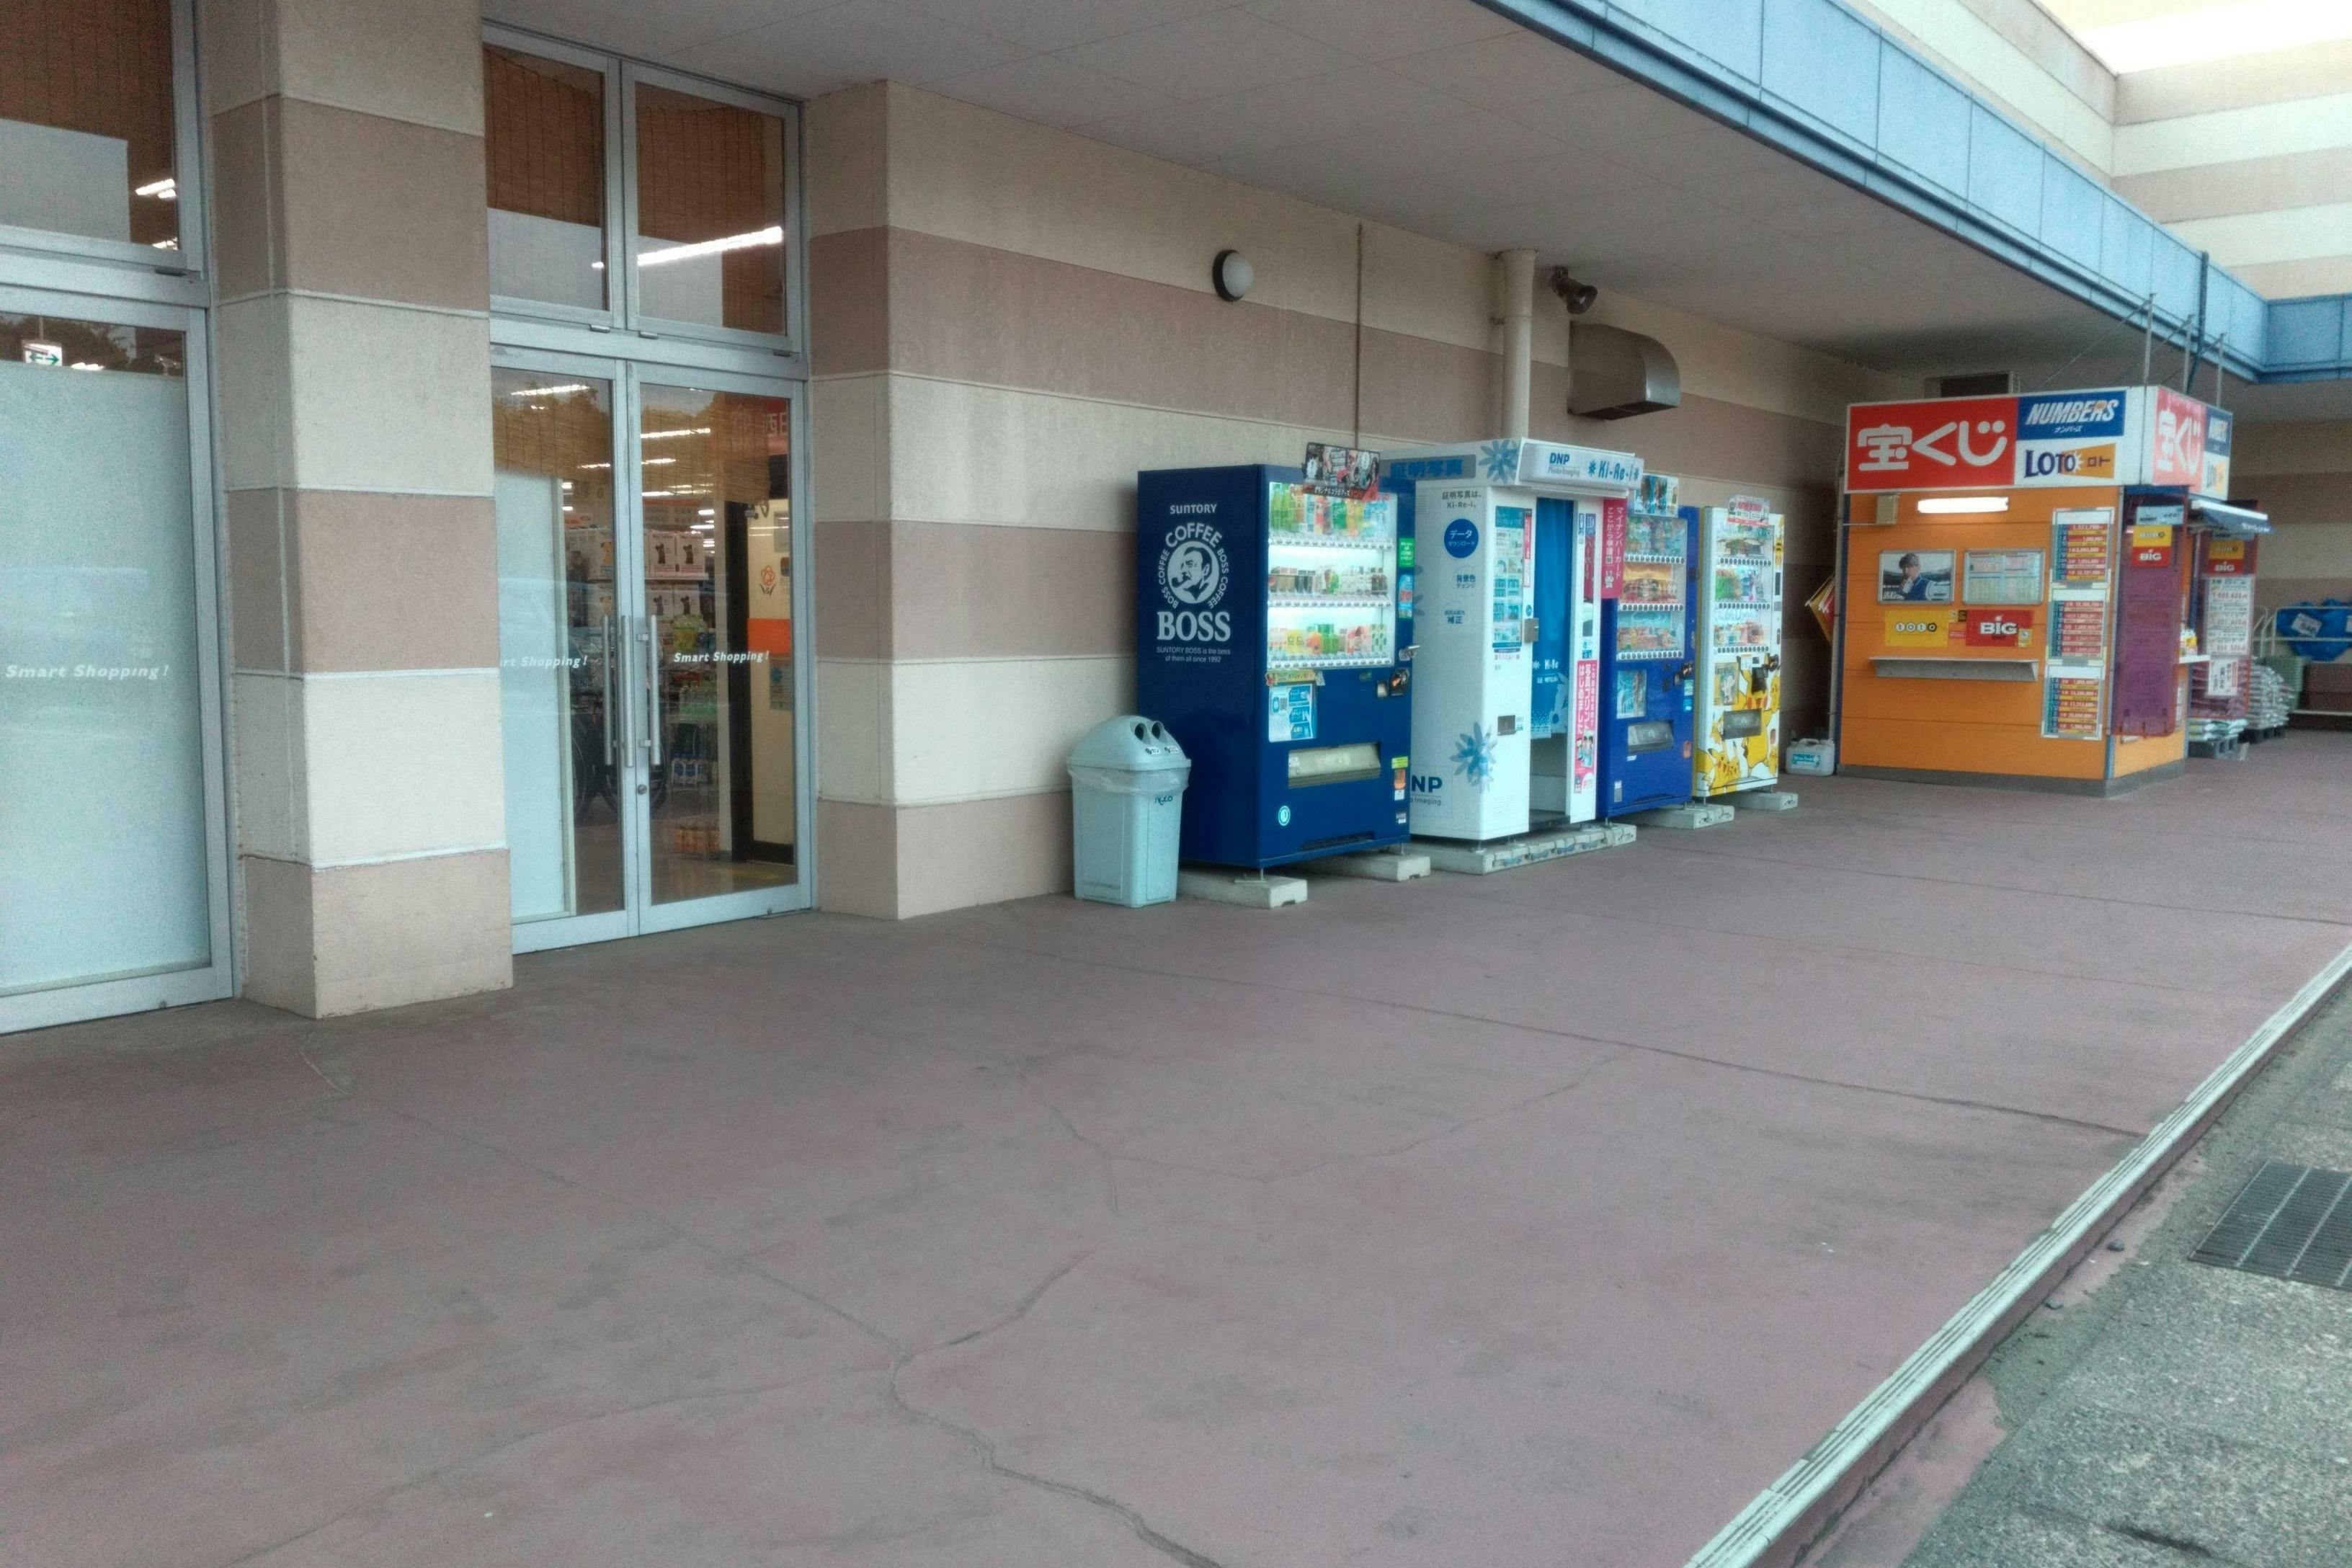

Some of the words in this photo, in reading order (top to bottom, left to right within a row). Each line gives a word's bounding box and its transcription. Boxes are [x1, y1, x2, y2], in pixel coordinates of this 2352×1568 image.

[2024, 398, 2119, 426] NUMBERS
[2053, 425, 2084, 434] ナンバーズ
[1857, 420, 2008, 471] 宝くじ
[1549, 452, 1571, 466] DNP
[2023, 448, 2076, 479] LOTO
[2087, 455, 2111, 468] ロト
[1170, 504, 1218, 514] SUNTORY
[1165, 522, 1223, 548] COFFEE
[1449, 529, 1473, 539] データ
[1158, 548, 1170, 585] COFFEE
[1216, 548, 1229, 574] BOSS
[1161, 586, 1180, 609] BOSS
[1207, 576, 1229, 610] COFFEE
[1157, 611, 1231, 642] BOSS
[1894, 621, 1938, 633] toto
[674, 651, 709, 663] Smart
[6, 664, 67, 678] Smart
[1410, 775, 1443, 793] NP
[1415, 797, 1442, 806] Imaging
